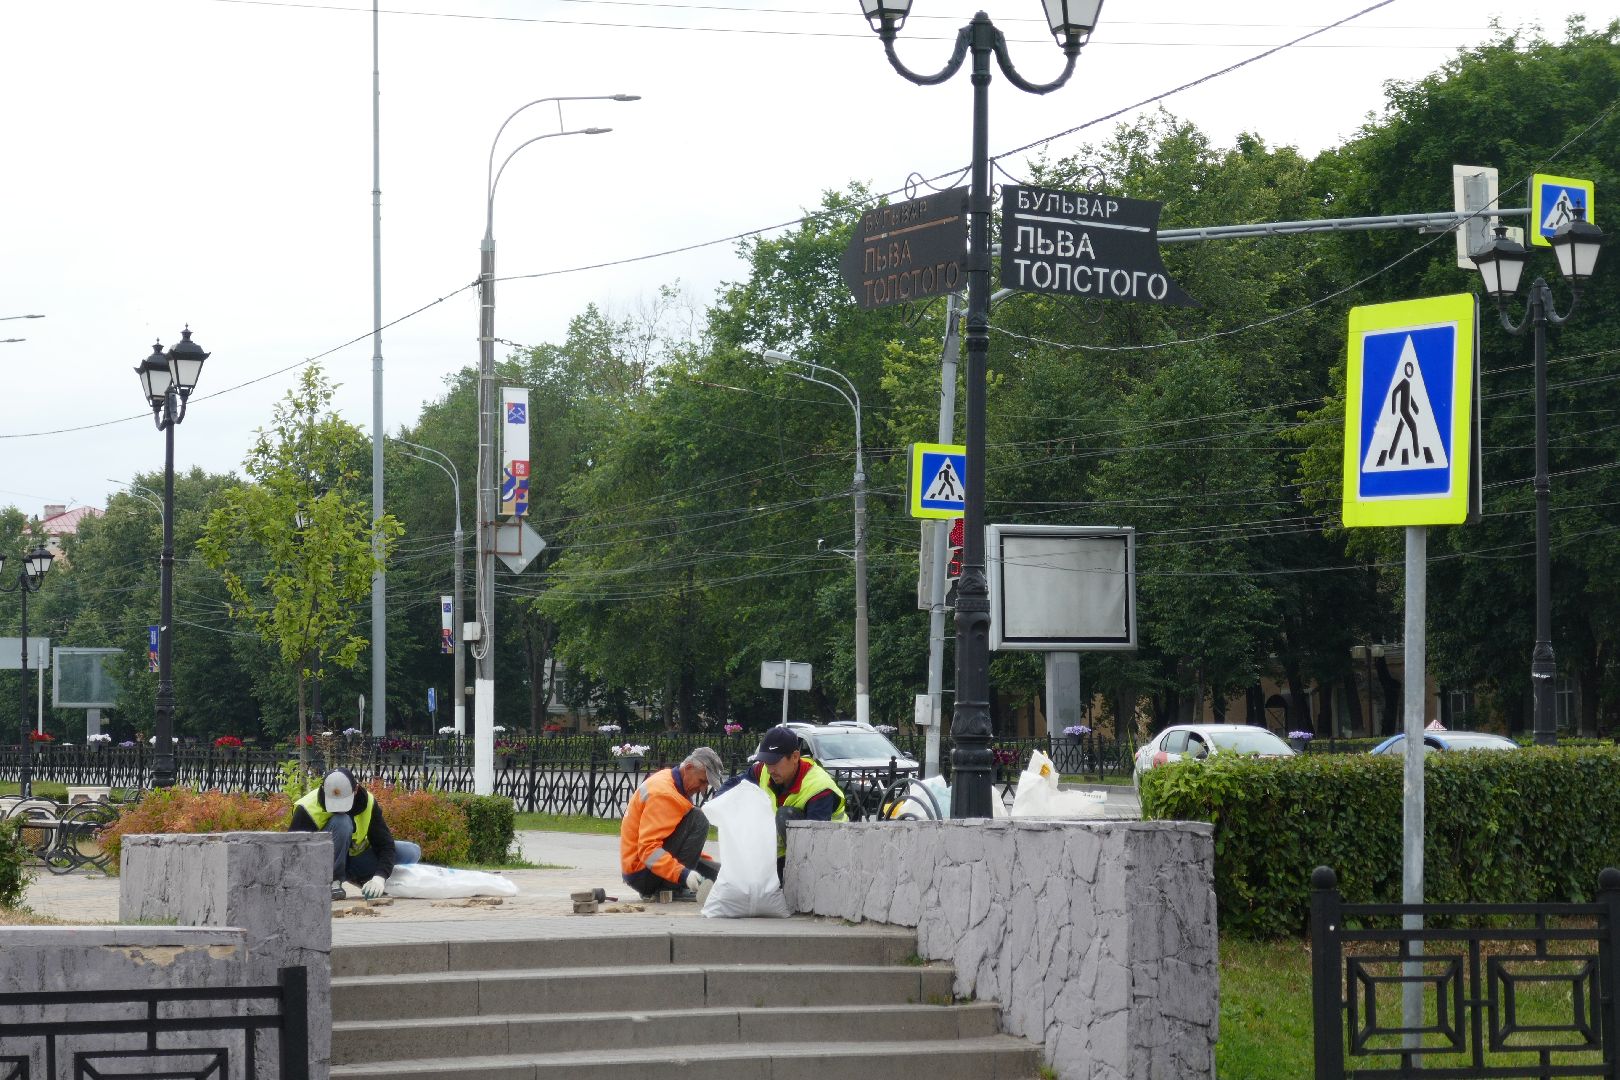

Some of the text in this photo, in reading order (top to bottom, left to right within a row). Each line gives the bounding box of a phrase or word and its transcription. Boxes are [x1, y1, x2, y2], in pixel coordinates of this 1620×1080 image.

[1018, 190, 1119, 219] БУЛЬВАР
[864, 239, 912, 273] ЛЬВА
[1013, 225, 1096, 260] ЛЬВА
[864, 261, 959, 307] ТОЛСТОГО
[1014, 259, 1168, 300] ТОЛСТОГО
